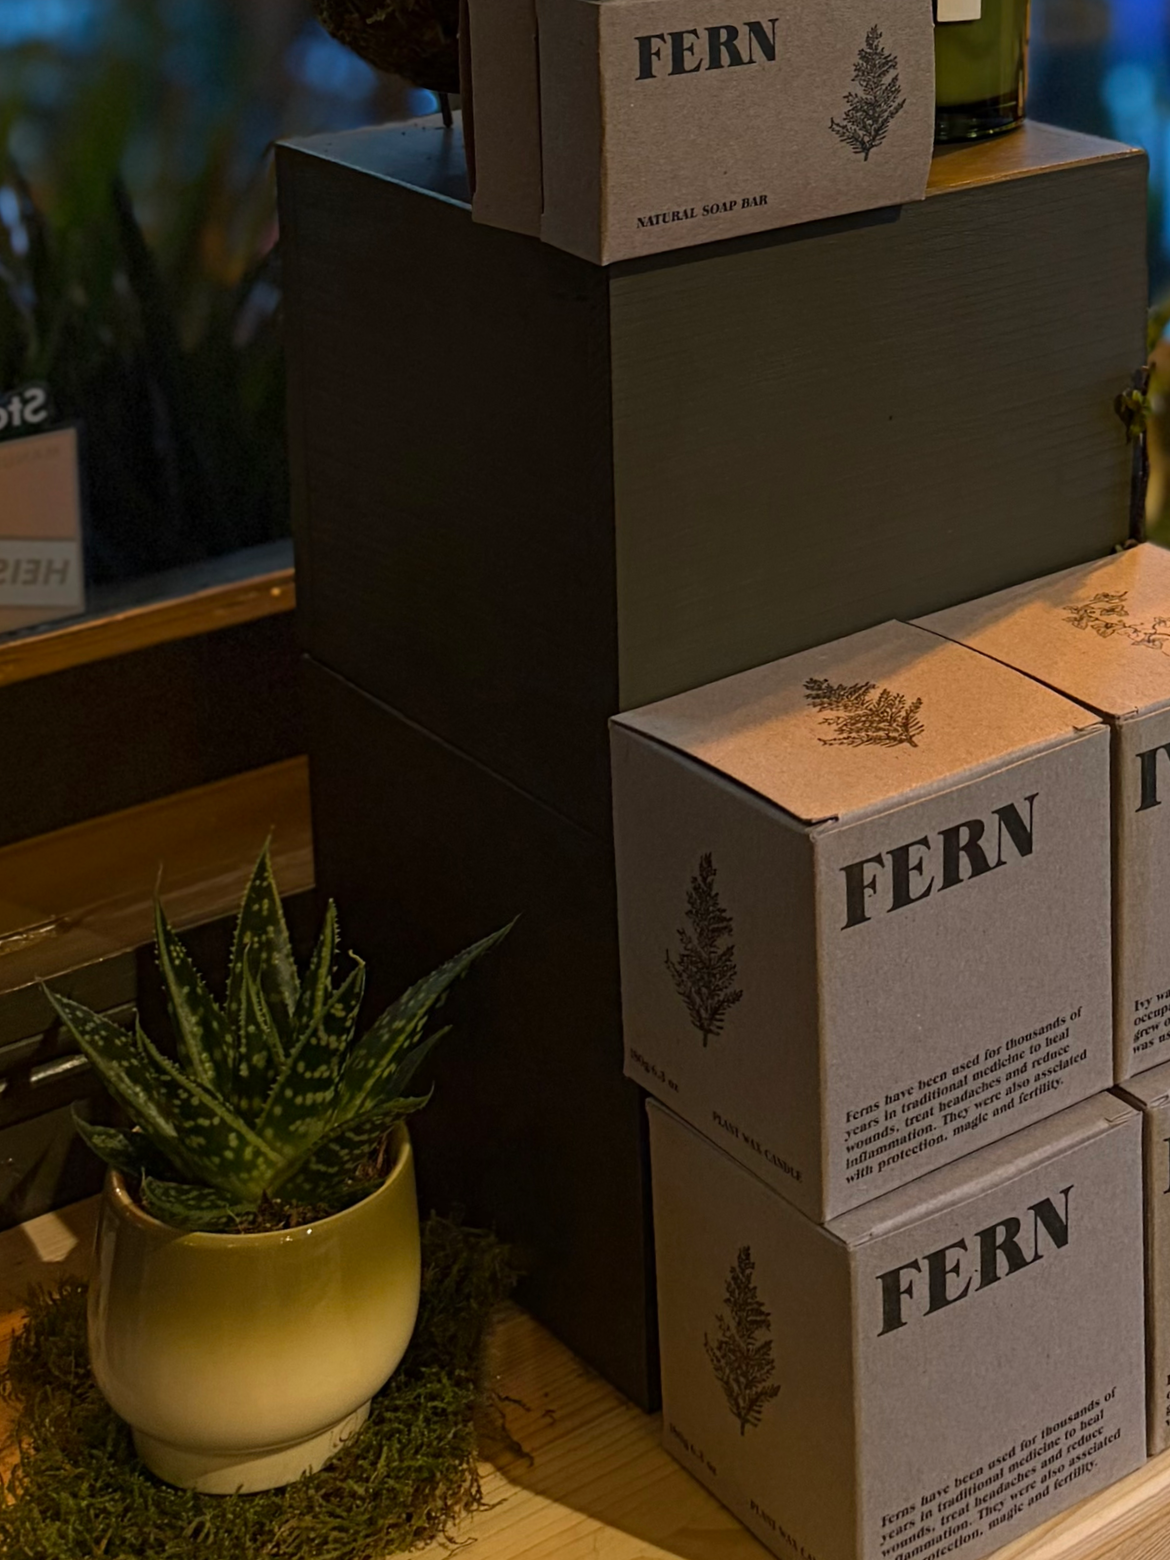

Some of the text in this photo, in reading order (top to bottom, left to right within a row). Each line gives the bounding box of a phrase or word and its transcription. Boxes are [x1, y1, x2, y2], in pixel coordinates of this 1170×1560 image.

[634, 18, 779, 80] FERN
[636, 194, 768, 229] NATURAL SOAP BAR
[839, 792, 1039, 931] FERN
[1133, 1022, 1161, 1043] grew
[1133, 1038, 1154, 1054] was
[1134, 997, 1153, 1012] Ivy
[844, 1027, 1069, 1142] years in traditional medicine to heal
[846, 1006, 1083, 1123] Ferns have been used for thousands of
[905, 1106, 934, 1128] treat
[938, 1076, 1001, 1113] headaches
[1005, 1061, 1028, 1081] and
[1032, 1044, 1070, 1069] reduce
[712, 1111, 739, 1138] PLANT
[764, 1149, 802, 1183] CANDLE
[845, 1165, 873, 1184] with
[953, 1112, 988, 1136] magic
[992, 1097, 1015, 1117] and
[1018, 1078, 1064, 1105] fertility.
[846, 1124, 937, 1170] inflammation.
[942, 1106, 970, 1126] They
[974, 1091, 1001, 1110] were
[1005, 1078, 1030, 1096] also
[875, 1184, 1074, 1337] FERN
[880, 1408, 1104, 1547] years in traditional medicine to heal
[881, 1386, 1117, 1528] Ferns have been used for thousands of
[941, 1502, 970, 1526] treat
[974, 1466, 1037, 1508] headaches
[1040, 1448, 1062, 1469] and
[1067, 1426, 1104, 1454] reduce
[977, 1499, 1006, 1520] They
[1010, 1480, 1037, 1501] were
[1040, 1464, 1065, 1484] also
[988, 1503, 1024, 1530] magic
[1027, 1485, 1050, 1507] and
[1054, 1460, 1098, 1491] fertility.
